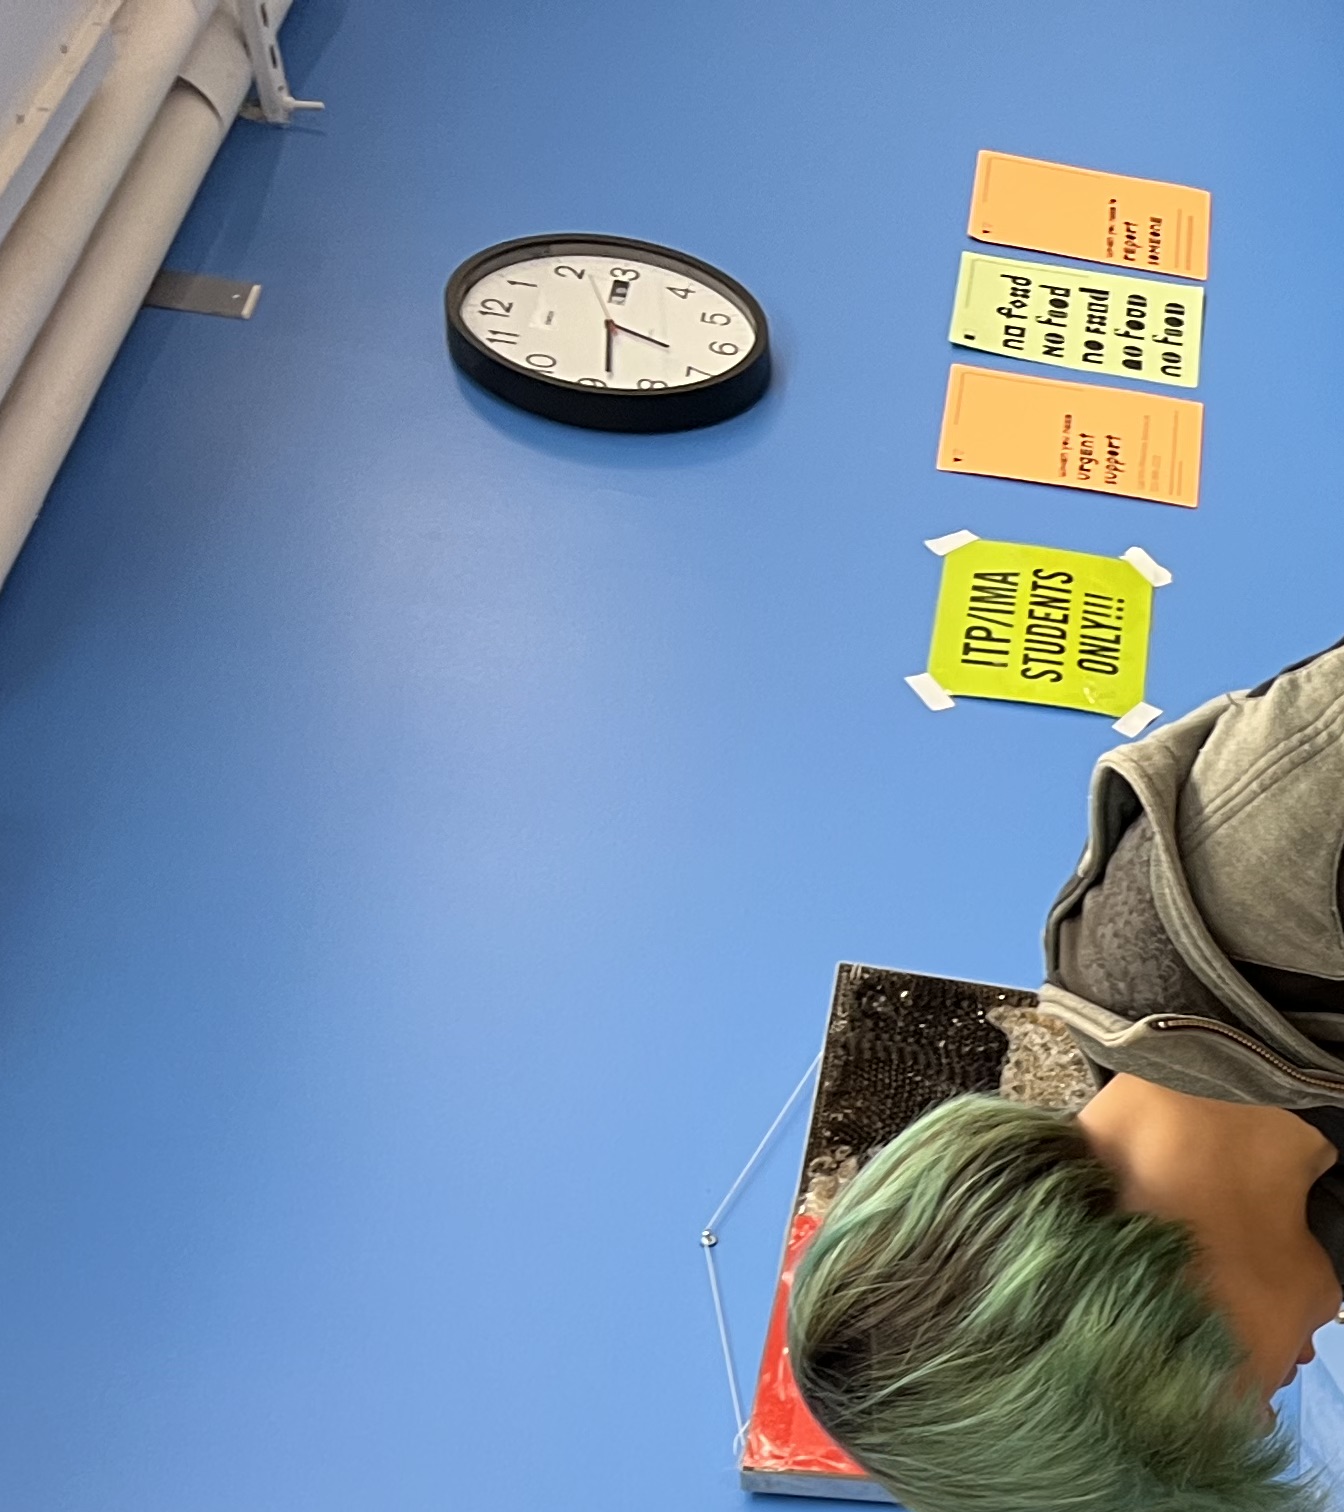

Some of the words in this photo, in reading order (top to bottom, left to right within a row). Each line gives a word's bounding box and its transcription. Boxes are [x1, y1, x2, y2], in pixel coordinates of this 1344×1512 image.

[1123, 221, 1144, 262] report
[554, 265, 586, 280] 2
[610, 266, 640, 281] 3
[506, 280, 538, 288] 1
[666, 284, 697, 300] 4
[996, 274, 1032, 319] food
[477, 298, 513, 317] 12
[700, 311, 732, 327] 5
[486, 329, 520, 345] 11
[1002, 325, 1027, 350] no
[708, 340, 739, 356] 6
[685, 366, 713, 378] 7
[1077, 433, 1100, 481] urgent
[1104, 435, 1126, 485] support
[961, 571, 1021, 668] ITP/IMA
[1020, 568, 1074, 683] STUDENTS
[1077, 592, 1126, 676] ONLY!!!
